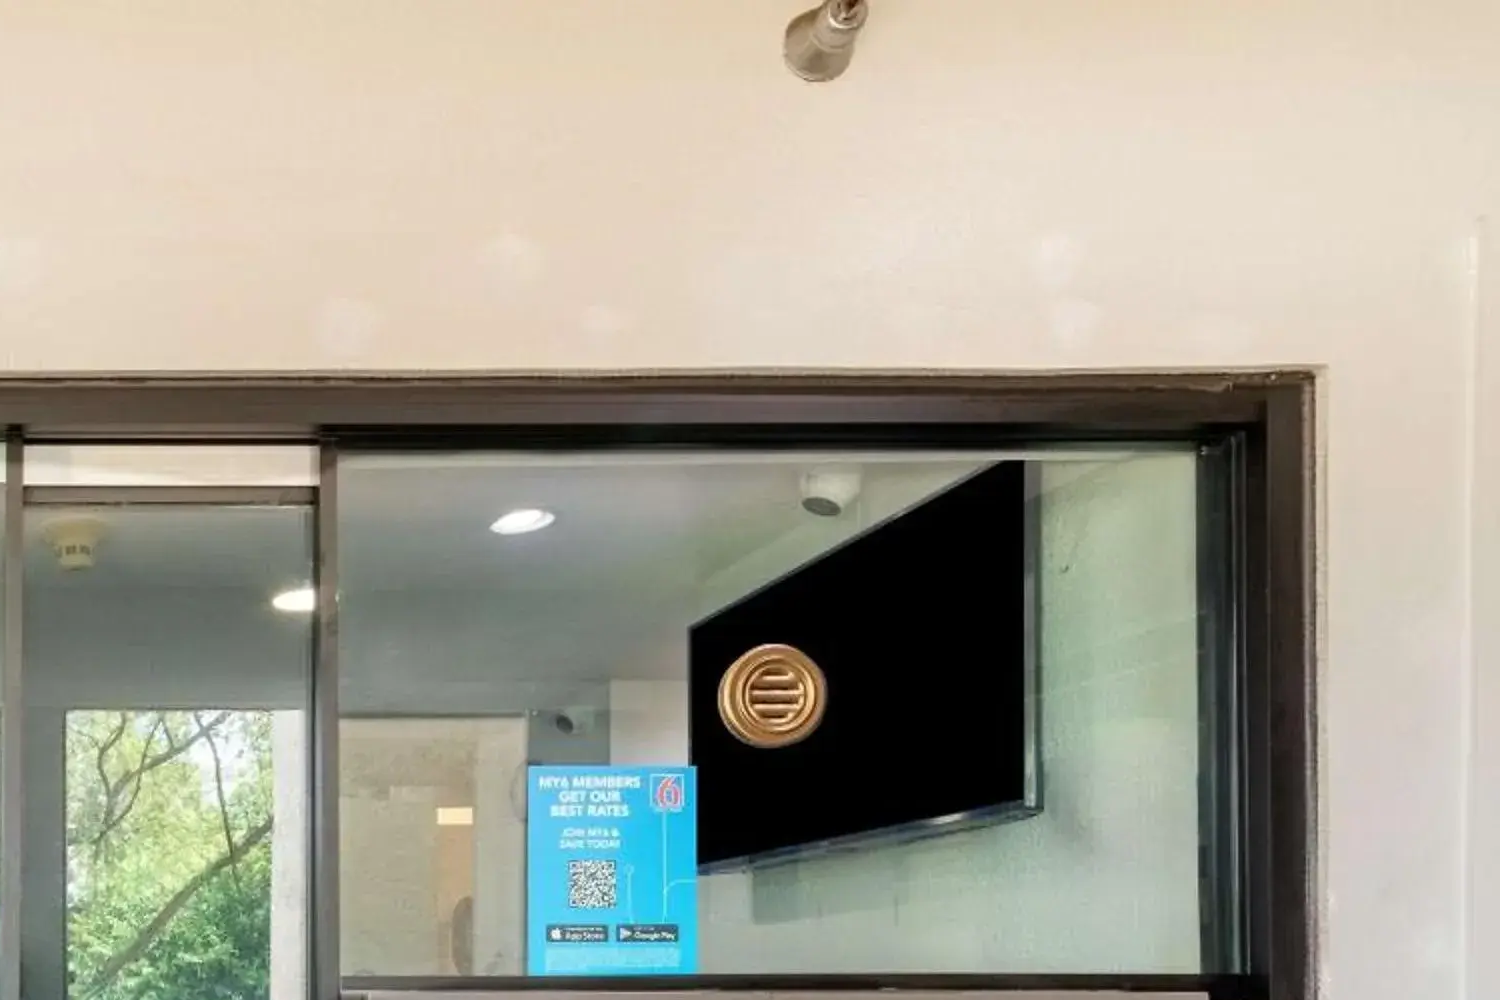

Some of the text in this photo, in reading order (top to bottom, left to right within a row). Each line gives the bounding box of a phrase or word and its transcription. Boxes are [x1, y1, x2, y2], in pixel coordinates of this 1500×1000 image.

[539, 776, 641, 789] MY6 MEMBERS
[559, 791, 621, 803] GET OUR
[657, 775, 682, 810] 6
[551, 805, 630, 817] BEST RATES
[634, 931, 676, 942] Google Play
